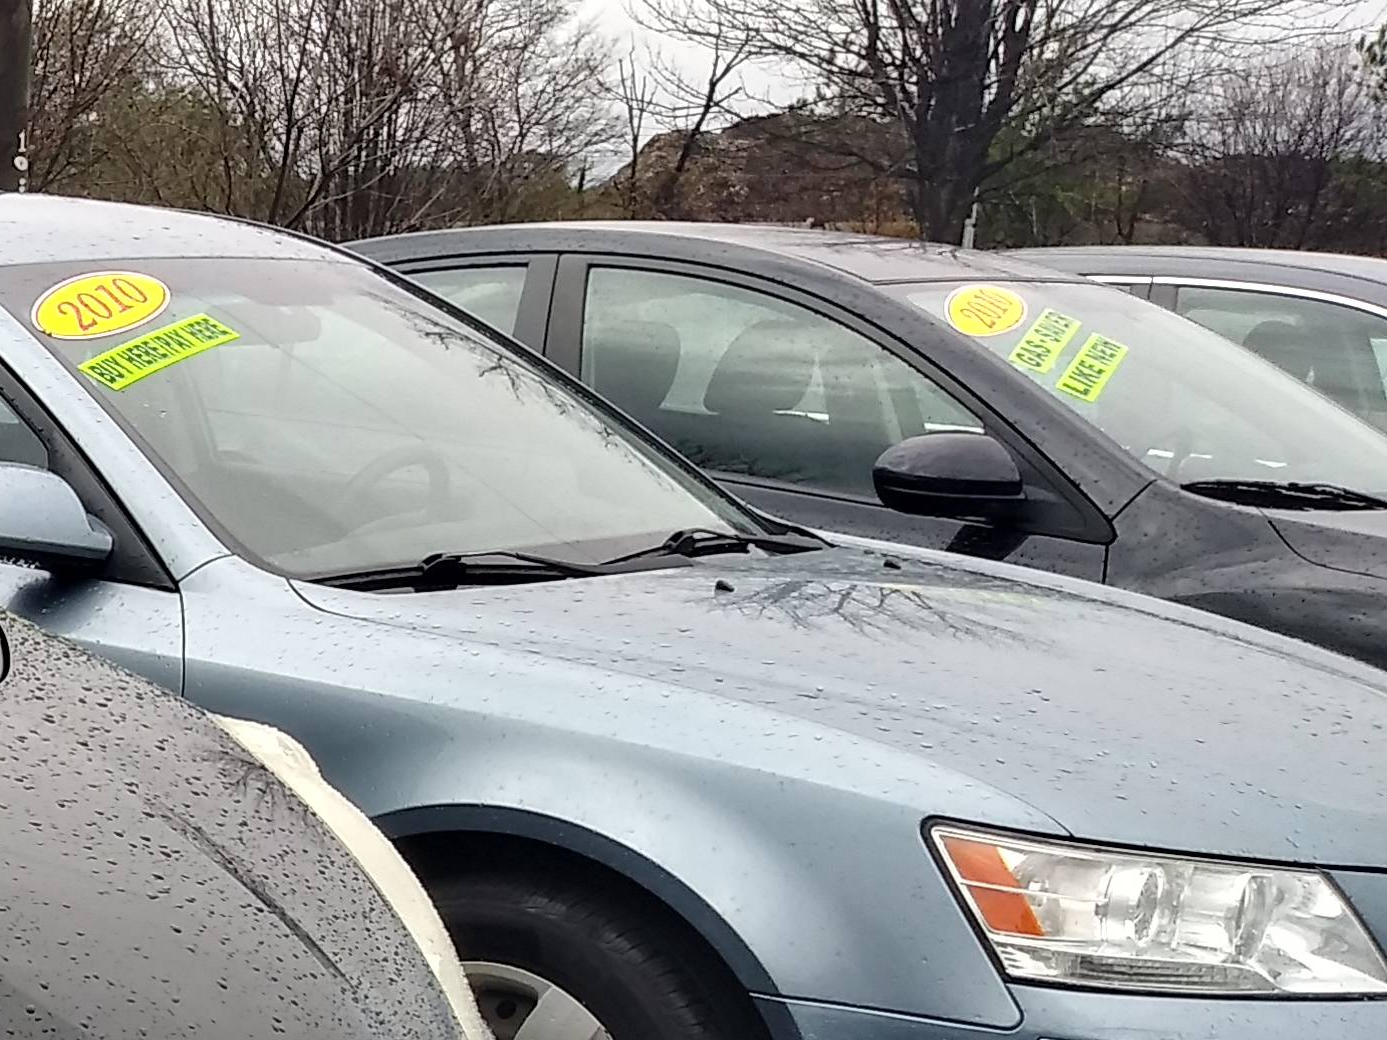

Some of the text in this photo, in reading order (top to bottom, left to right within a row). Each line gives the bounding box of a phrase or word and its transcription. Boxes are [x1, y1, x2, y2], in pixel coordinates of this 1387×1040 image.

[58, 278, 148, 331] 2010
[88, 356, 134, 385] BUY
[178, 317, 233, 346] HERE
[1062, 358, 1106, 397] LIKE
